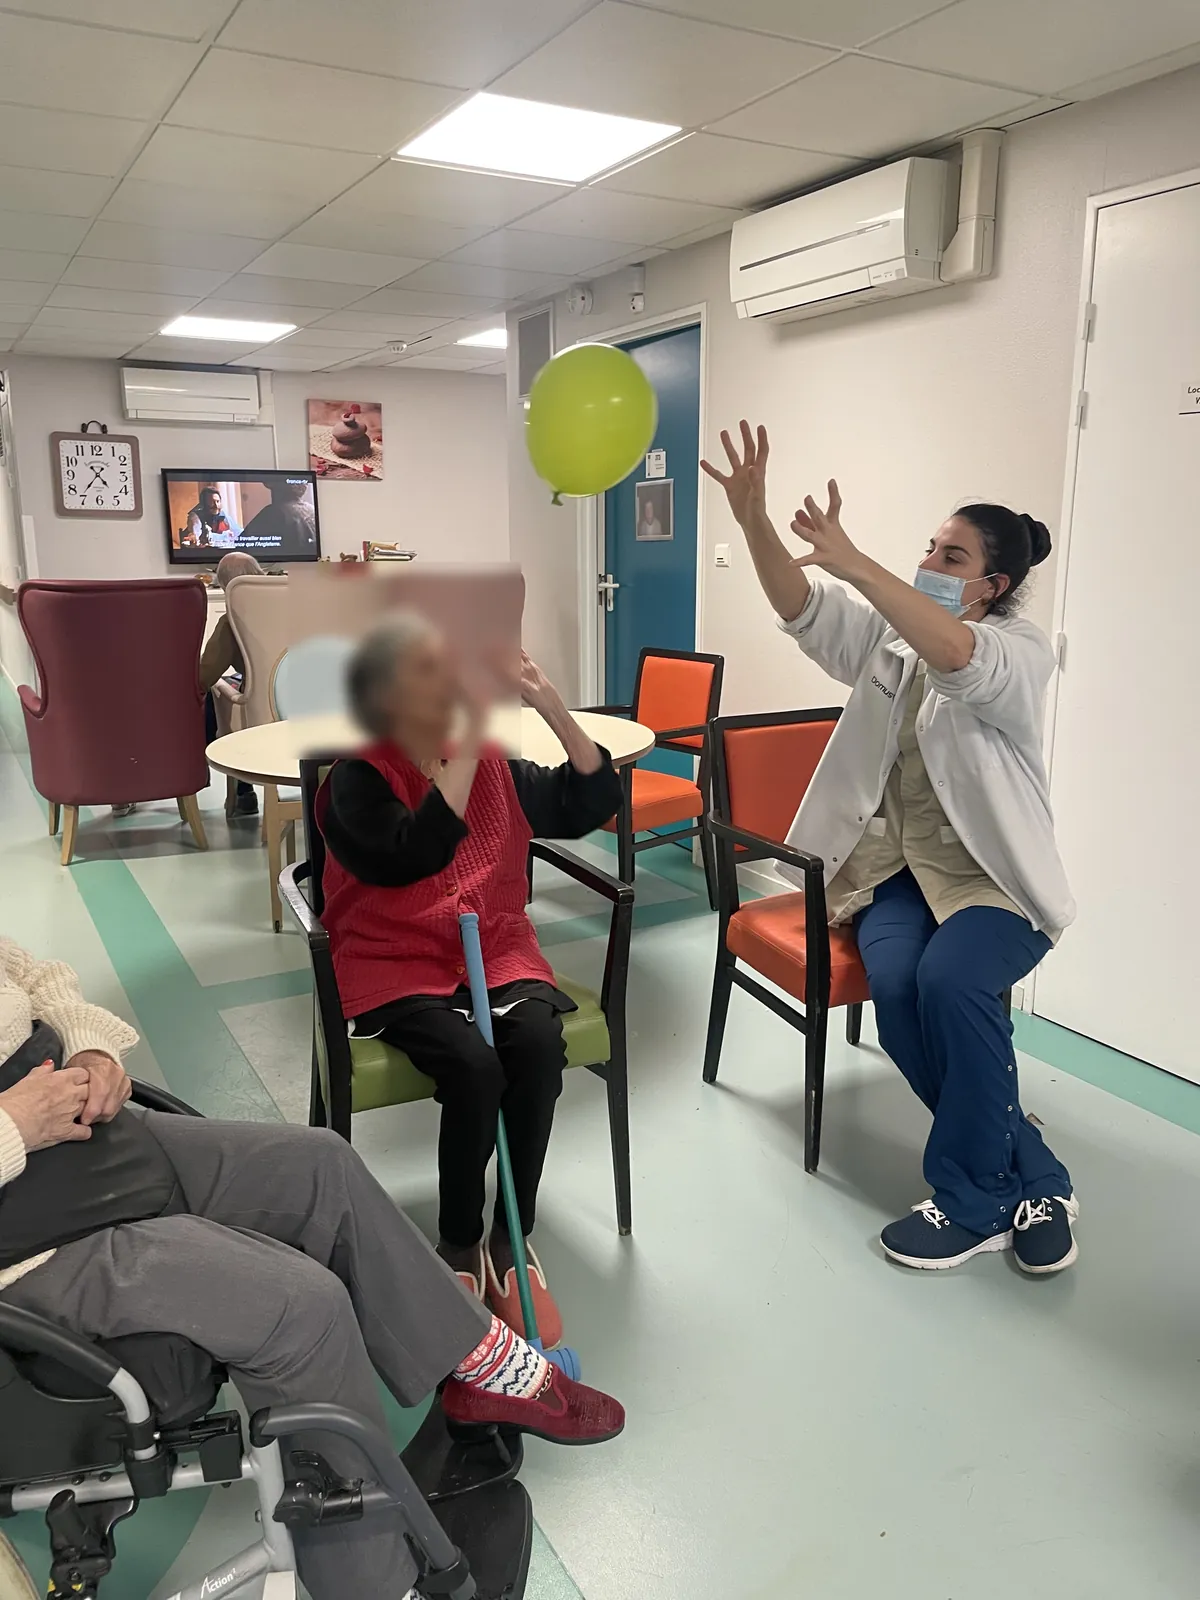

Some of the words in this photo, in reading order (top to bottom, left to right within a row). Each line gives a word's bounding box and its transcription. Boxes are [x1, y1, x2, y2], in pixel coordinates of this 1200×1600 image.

[75, 445, 84, 456] 11
[90, 445, 103, 456] 12
[111, 446, 115, 457] 1
[66, 456, 78, 467] 10
[118, 455, 127, 466] 2
[66, 469, 75, 480] 9
[119, 471, 128, 482] 3
[67, 484, 77, 495] 8
[119, 484, 129, 495] 4
[79, 494, 87, 505] 7
[95, 495, 104, 506] 6
[112, 495, 120, 506] 5
